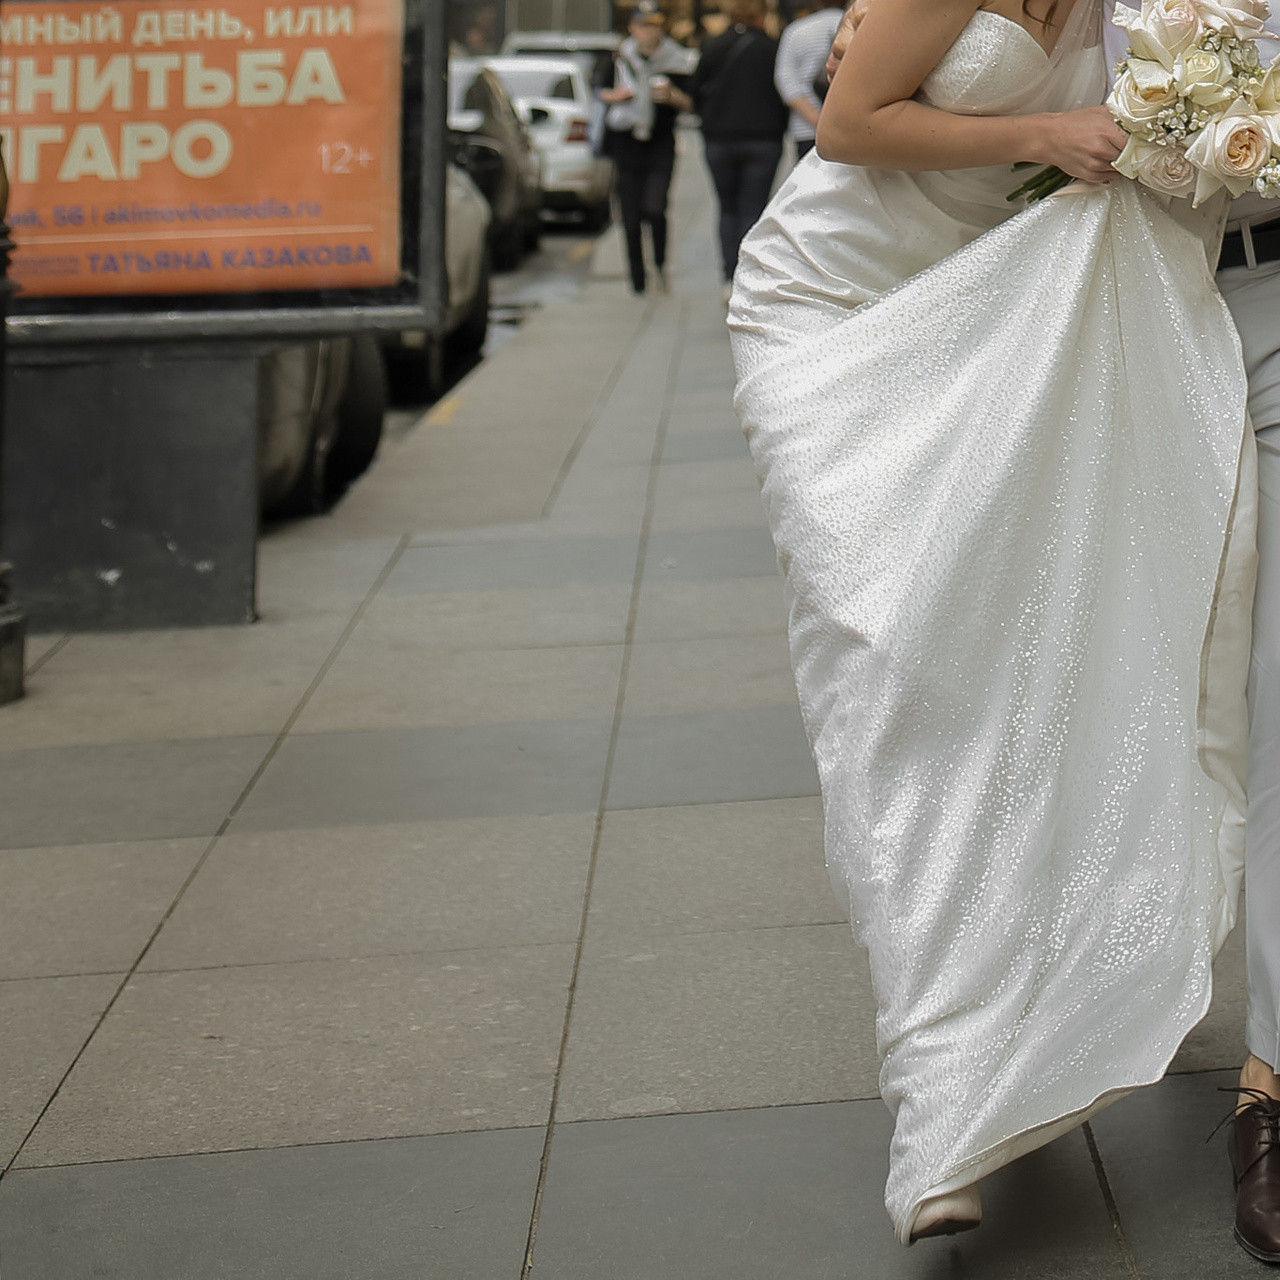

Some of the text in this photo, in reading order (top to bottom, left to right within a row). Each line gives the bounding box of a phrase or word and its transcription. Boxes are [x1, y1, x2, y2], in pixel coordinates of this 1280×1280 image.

[132, 9, 255, 47] ДЕНЬ,
[265, 6, 354, 37] ИЛИ
[0, 120, 233, 183] ГАРО
[317, 143, 374, 174] 12+
[53, 205, 86, 226] 56
[104, 198, 322, 226] akimovkomedia.ru
[87, 250, 214, 274] ТАТЬЯНА
[221, 243, 374, 270] КАЗАКОВА
